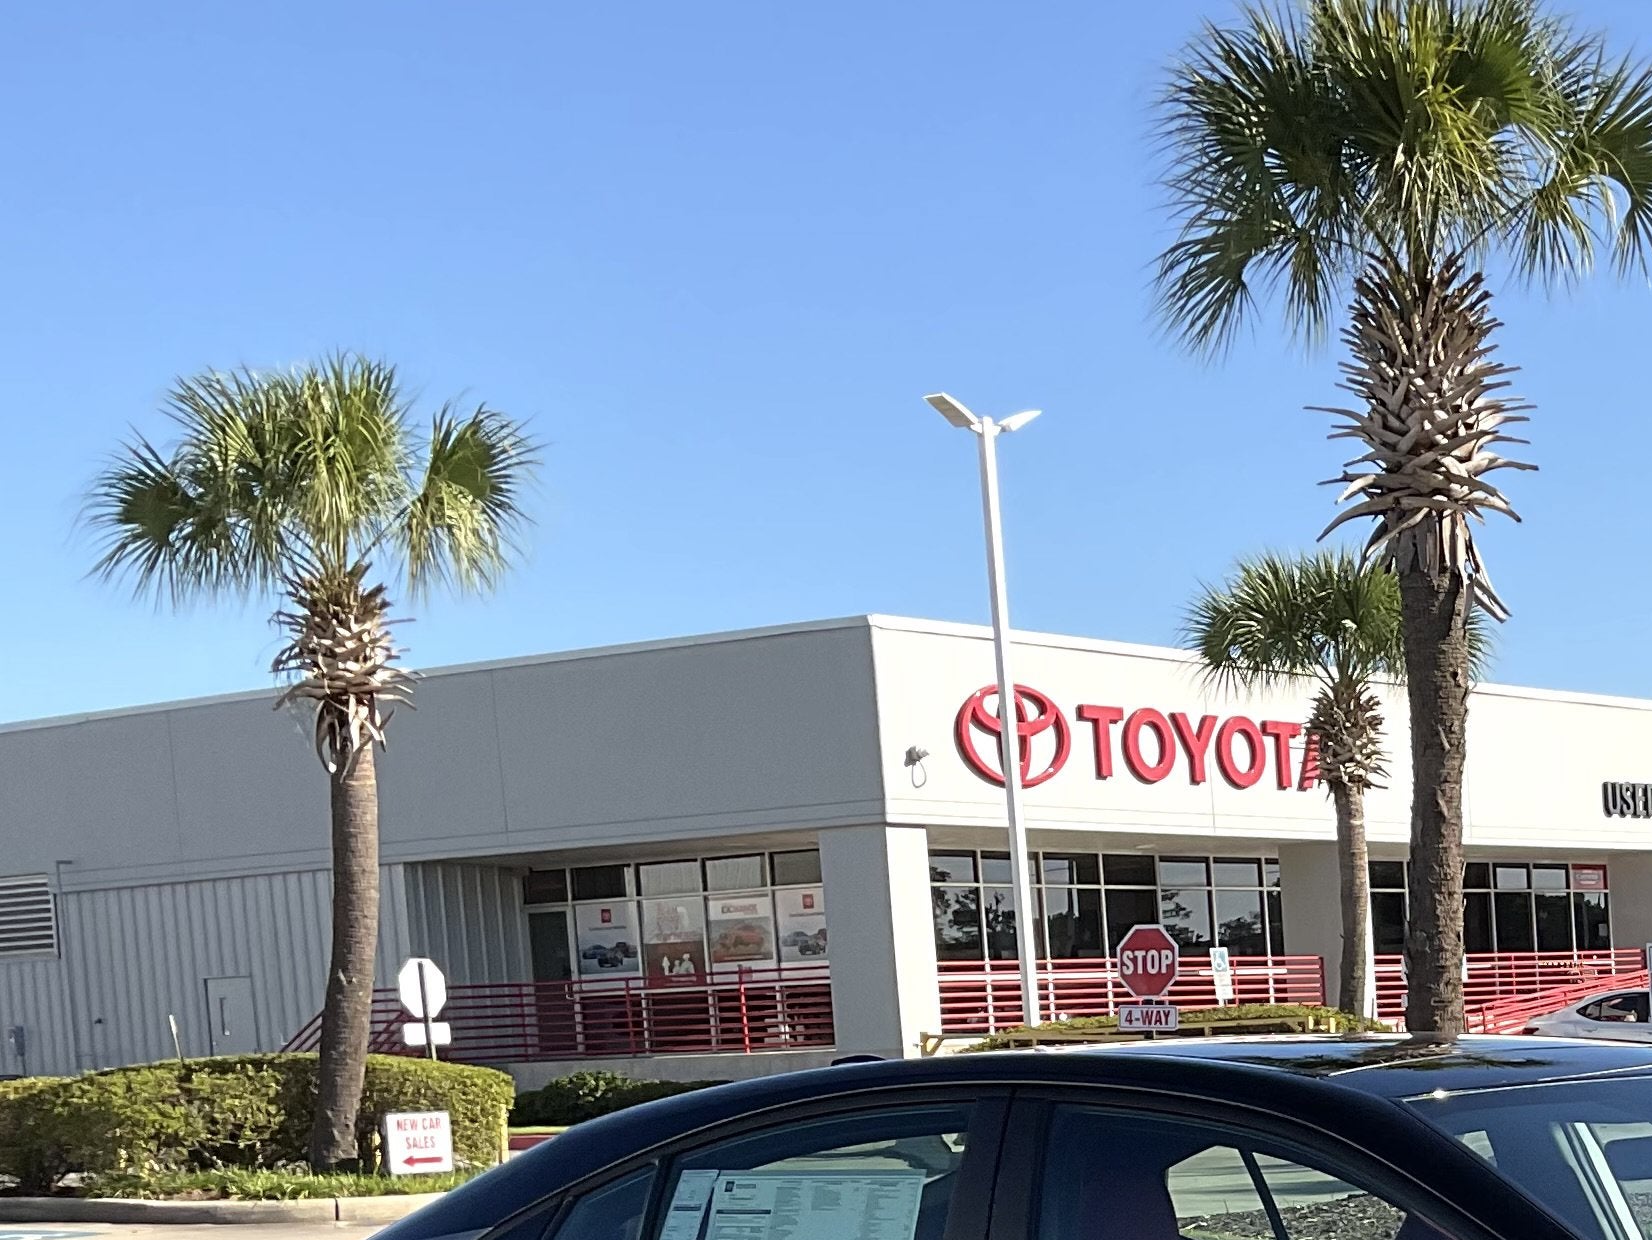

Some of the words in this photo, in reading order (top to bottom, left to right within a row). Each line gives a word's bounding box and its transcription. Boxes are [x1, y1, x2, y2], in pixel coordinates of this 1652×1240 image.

[1121, 949, 1173, 975] STOP
[1124, 1010, 1171, 1026] 4-WAY
[396, 1119, 418, 1131] NEW
[422, 1117, 442, 1130] CAR
[405, 1136, 436, 1149] SALES
